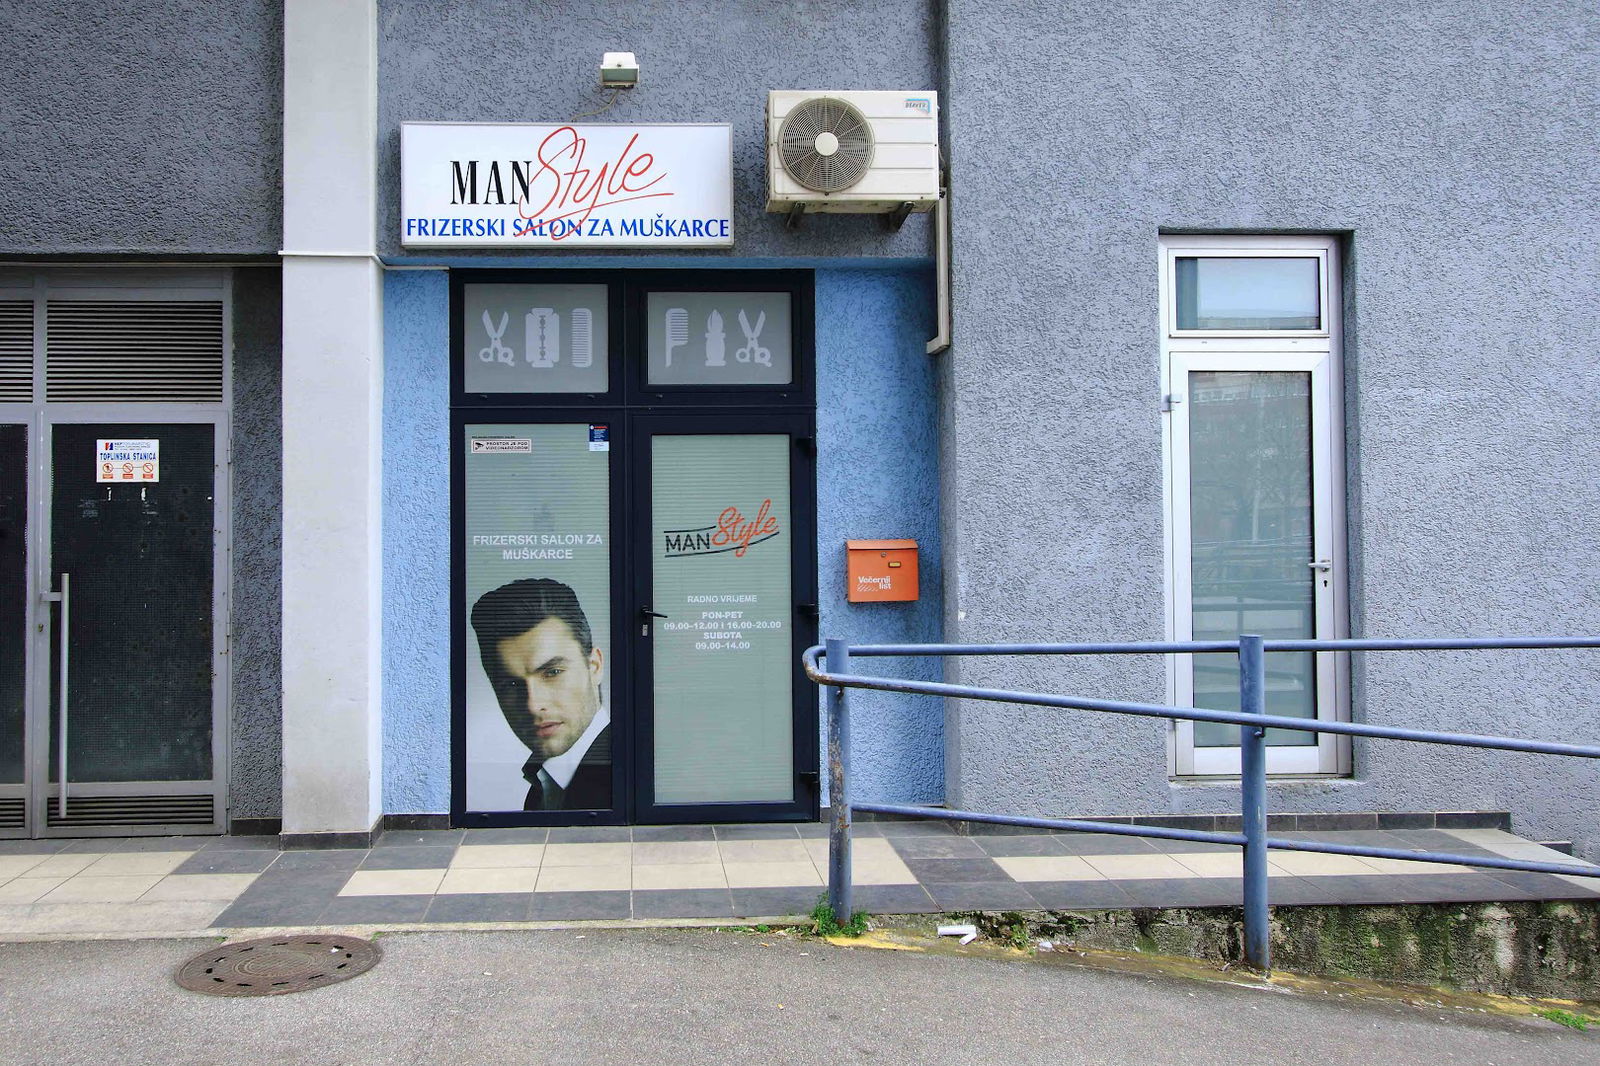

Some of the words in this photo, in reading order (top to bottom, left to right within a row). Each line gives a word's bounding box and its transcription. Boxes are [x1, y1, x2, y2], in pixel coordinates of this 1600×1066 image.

[449, 160, 532, 205] MAN
[518, 126, 670, 240] Style
[406, 218, 505, 237] FRIZERSKI
[512, 218, 583, 237] SALON
[587, 218, 619, 237] ZA
[619, 213, 729, 237] MUŠKARCE
[100, 452, 130, 460] TOPLINSKA
[133, 452, 156, 460] STANICA
[664, 532, 711, 553] MAN
[711, 498, 779, 558] Style
[473, 535, 538, 545] FRIZERSKI
[540, 534, 583, 545] SALON
[586, 534, 603, 545] ZA
[502, 547, 573, 560] MUŠKARCE
[687, 595, 719, 603] RADNO
[720, 595, 757, 603] VRIJEME
[701, 611, 743, 619] PON-PET
[663, 622, 719, 630] 09.00-12.00
[726, 621, 782, 629] 16.00-20.00
[703, 631, 742, 640] SUBOTA
[695, 641, 751, 649] 09.00-14.00
